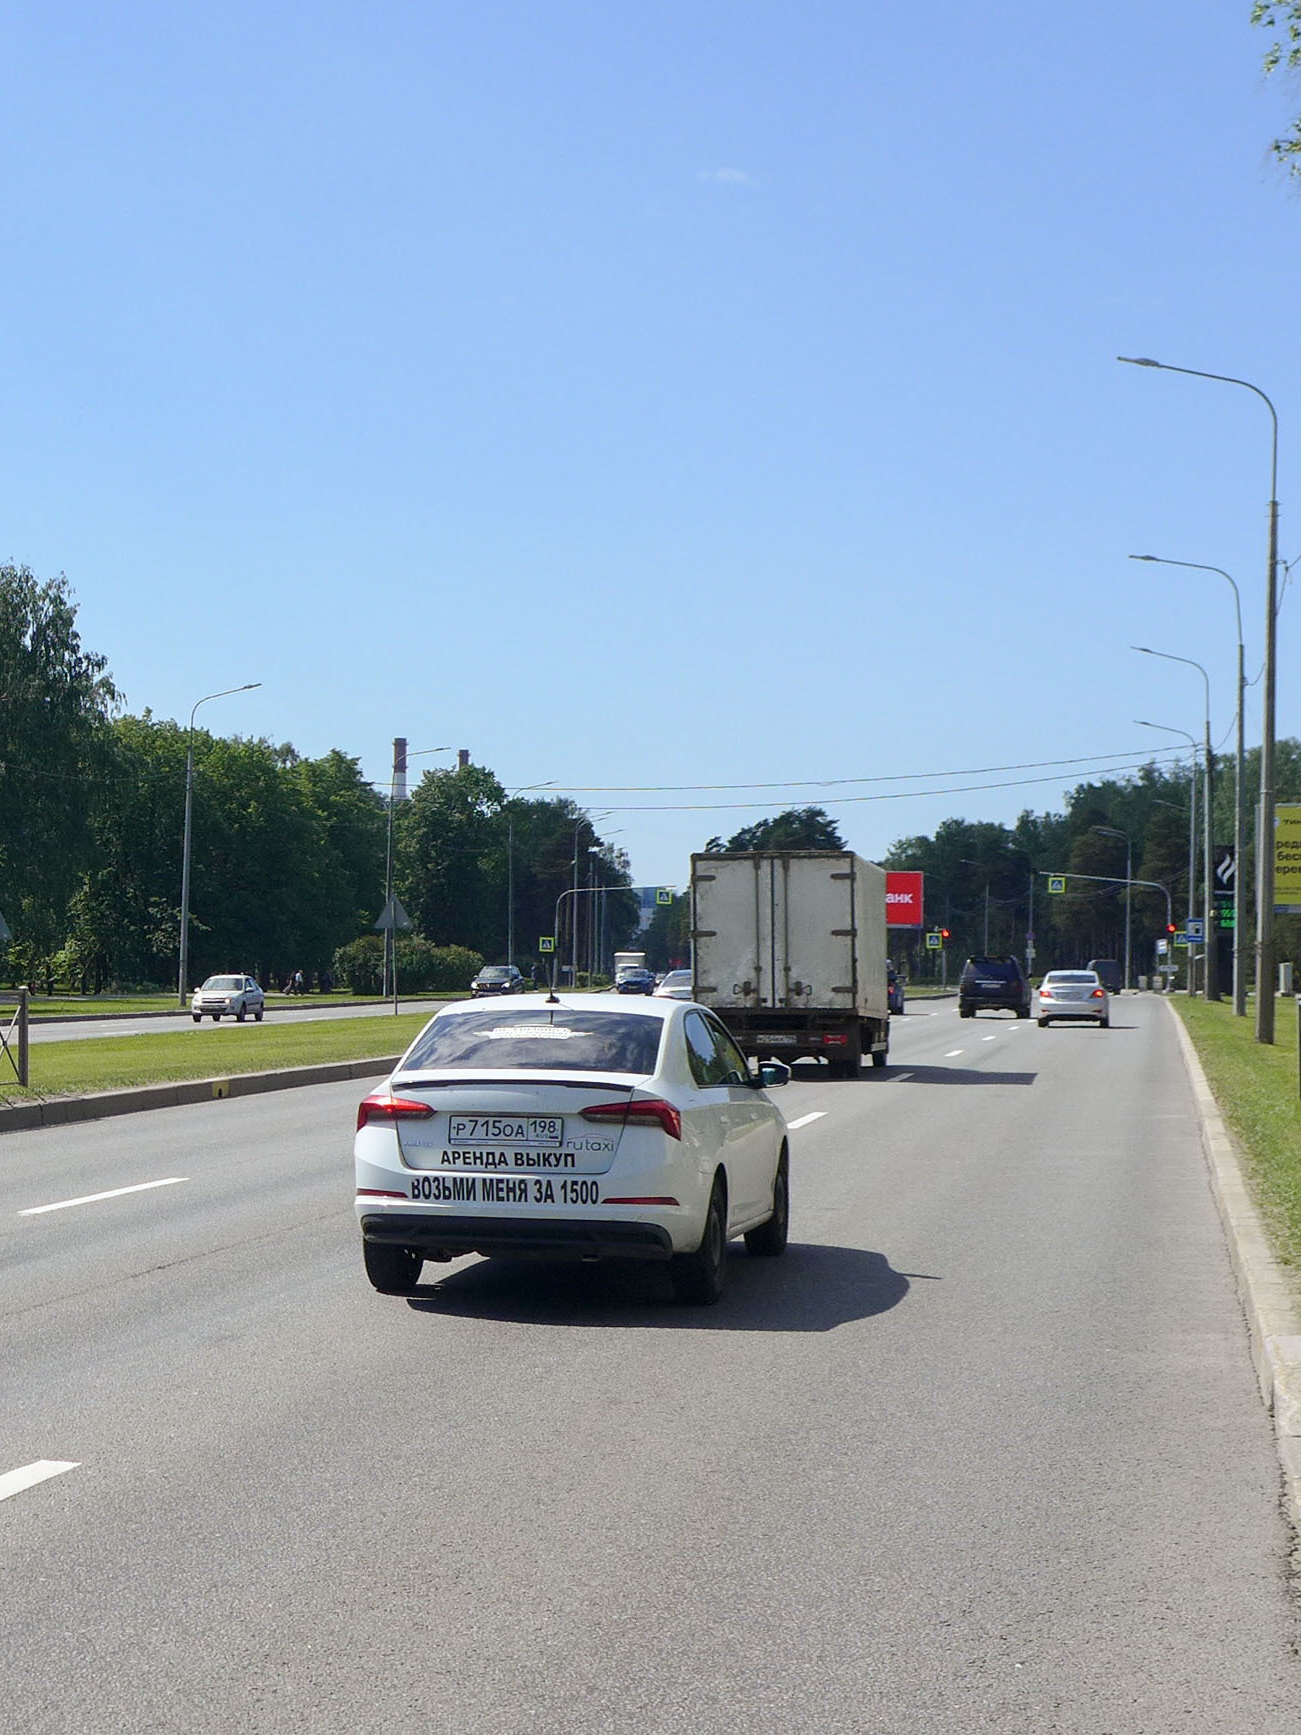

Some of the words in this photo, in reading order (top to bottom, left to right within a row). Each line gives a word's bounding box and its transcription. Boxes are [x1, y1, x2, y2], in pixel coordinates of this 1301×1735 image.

[1277, 851, 1301, 860] бес
[885, 893, 913, 904] анк
[441, 1151, 508, 1169] АРЕНДА
[514, 1152, 575, 1168] ВЫКУП
[411, 1177, 477, 1201] ВОЗЬМИ
[482, 1179, 528, 1203] МЕНЯ
[533, 1180, 555, 1204] ЗА
[560, 1180, 599, 1205] 1500
